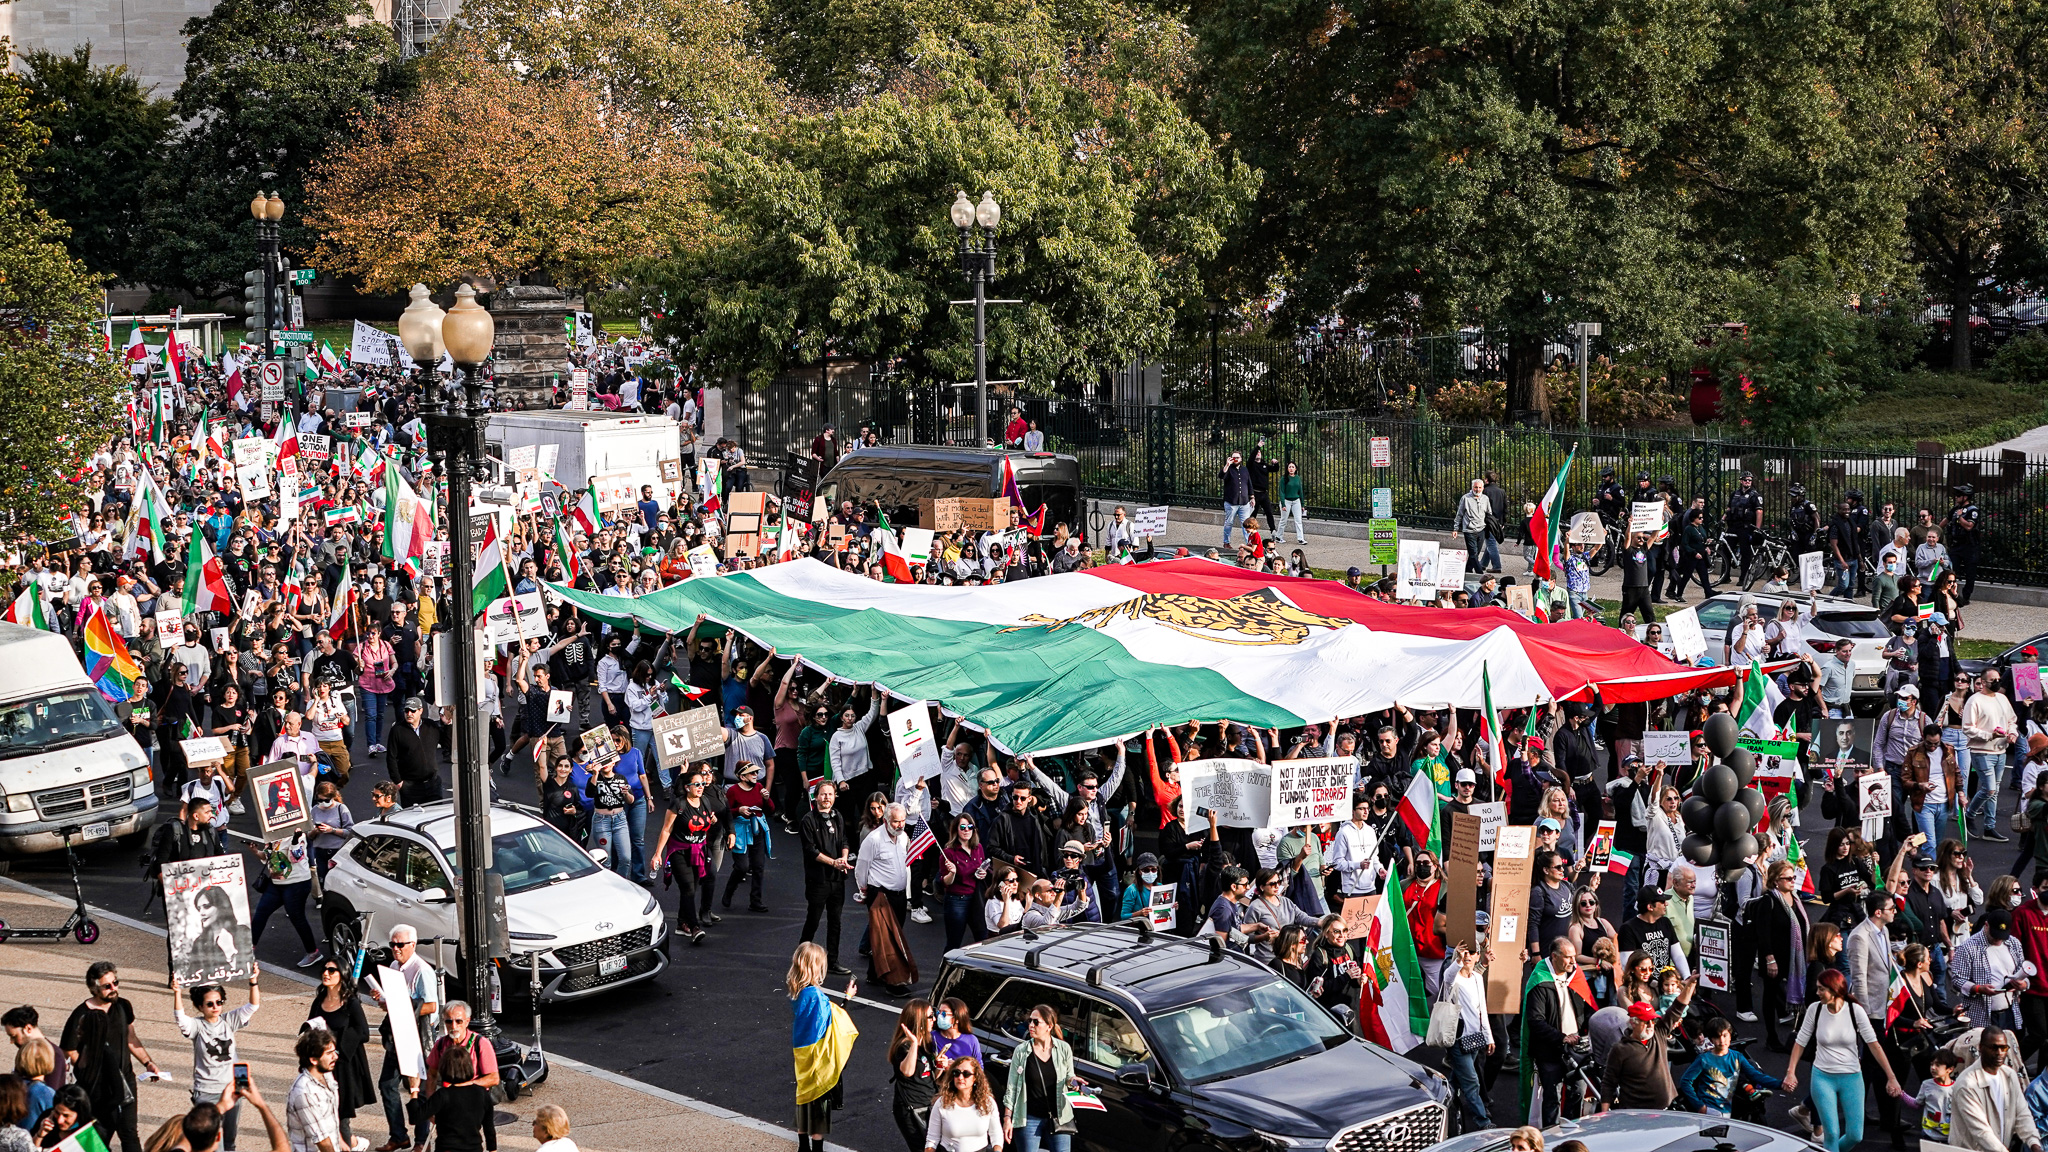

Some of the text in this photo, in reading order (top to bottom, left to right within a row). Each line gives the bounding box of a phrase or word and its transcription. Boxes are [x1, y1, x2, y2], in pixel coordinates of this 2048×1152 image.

[302, 435, 323, 443] ONE
[798, 505, 808, 517] LIFE
[1280, 763, 1353, 778] NOT ANOTHER NICKLE
[1217, 772, 1271, 787] FUCKS WITH
[1280, 776, 1347, 791] NOT ANOTHER DIME
[1194, 785, 1212, 798] THE
[1280, 787, 1347, 804] FUNDING TERRORIST
[1208, 795, 1238, 809] GEN-Z
[1295, 804, 1334, 819] IS A CRIME
[165, 857, 240, 879] تفتیش عقاید
[168, 872, 243, 895] و کشتار ایرانیان
[1645, 930, 1664, 940] IRAN
[1709, 939, 1718, 947] LIFE
[208, 967, 243, 981] متوقف
